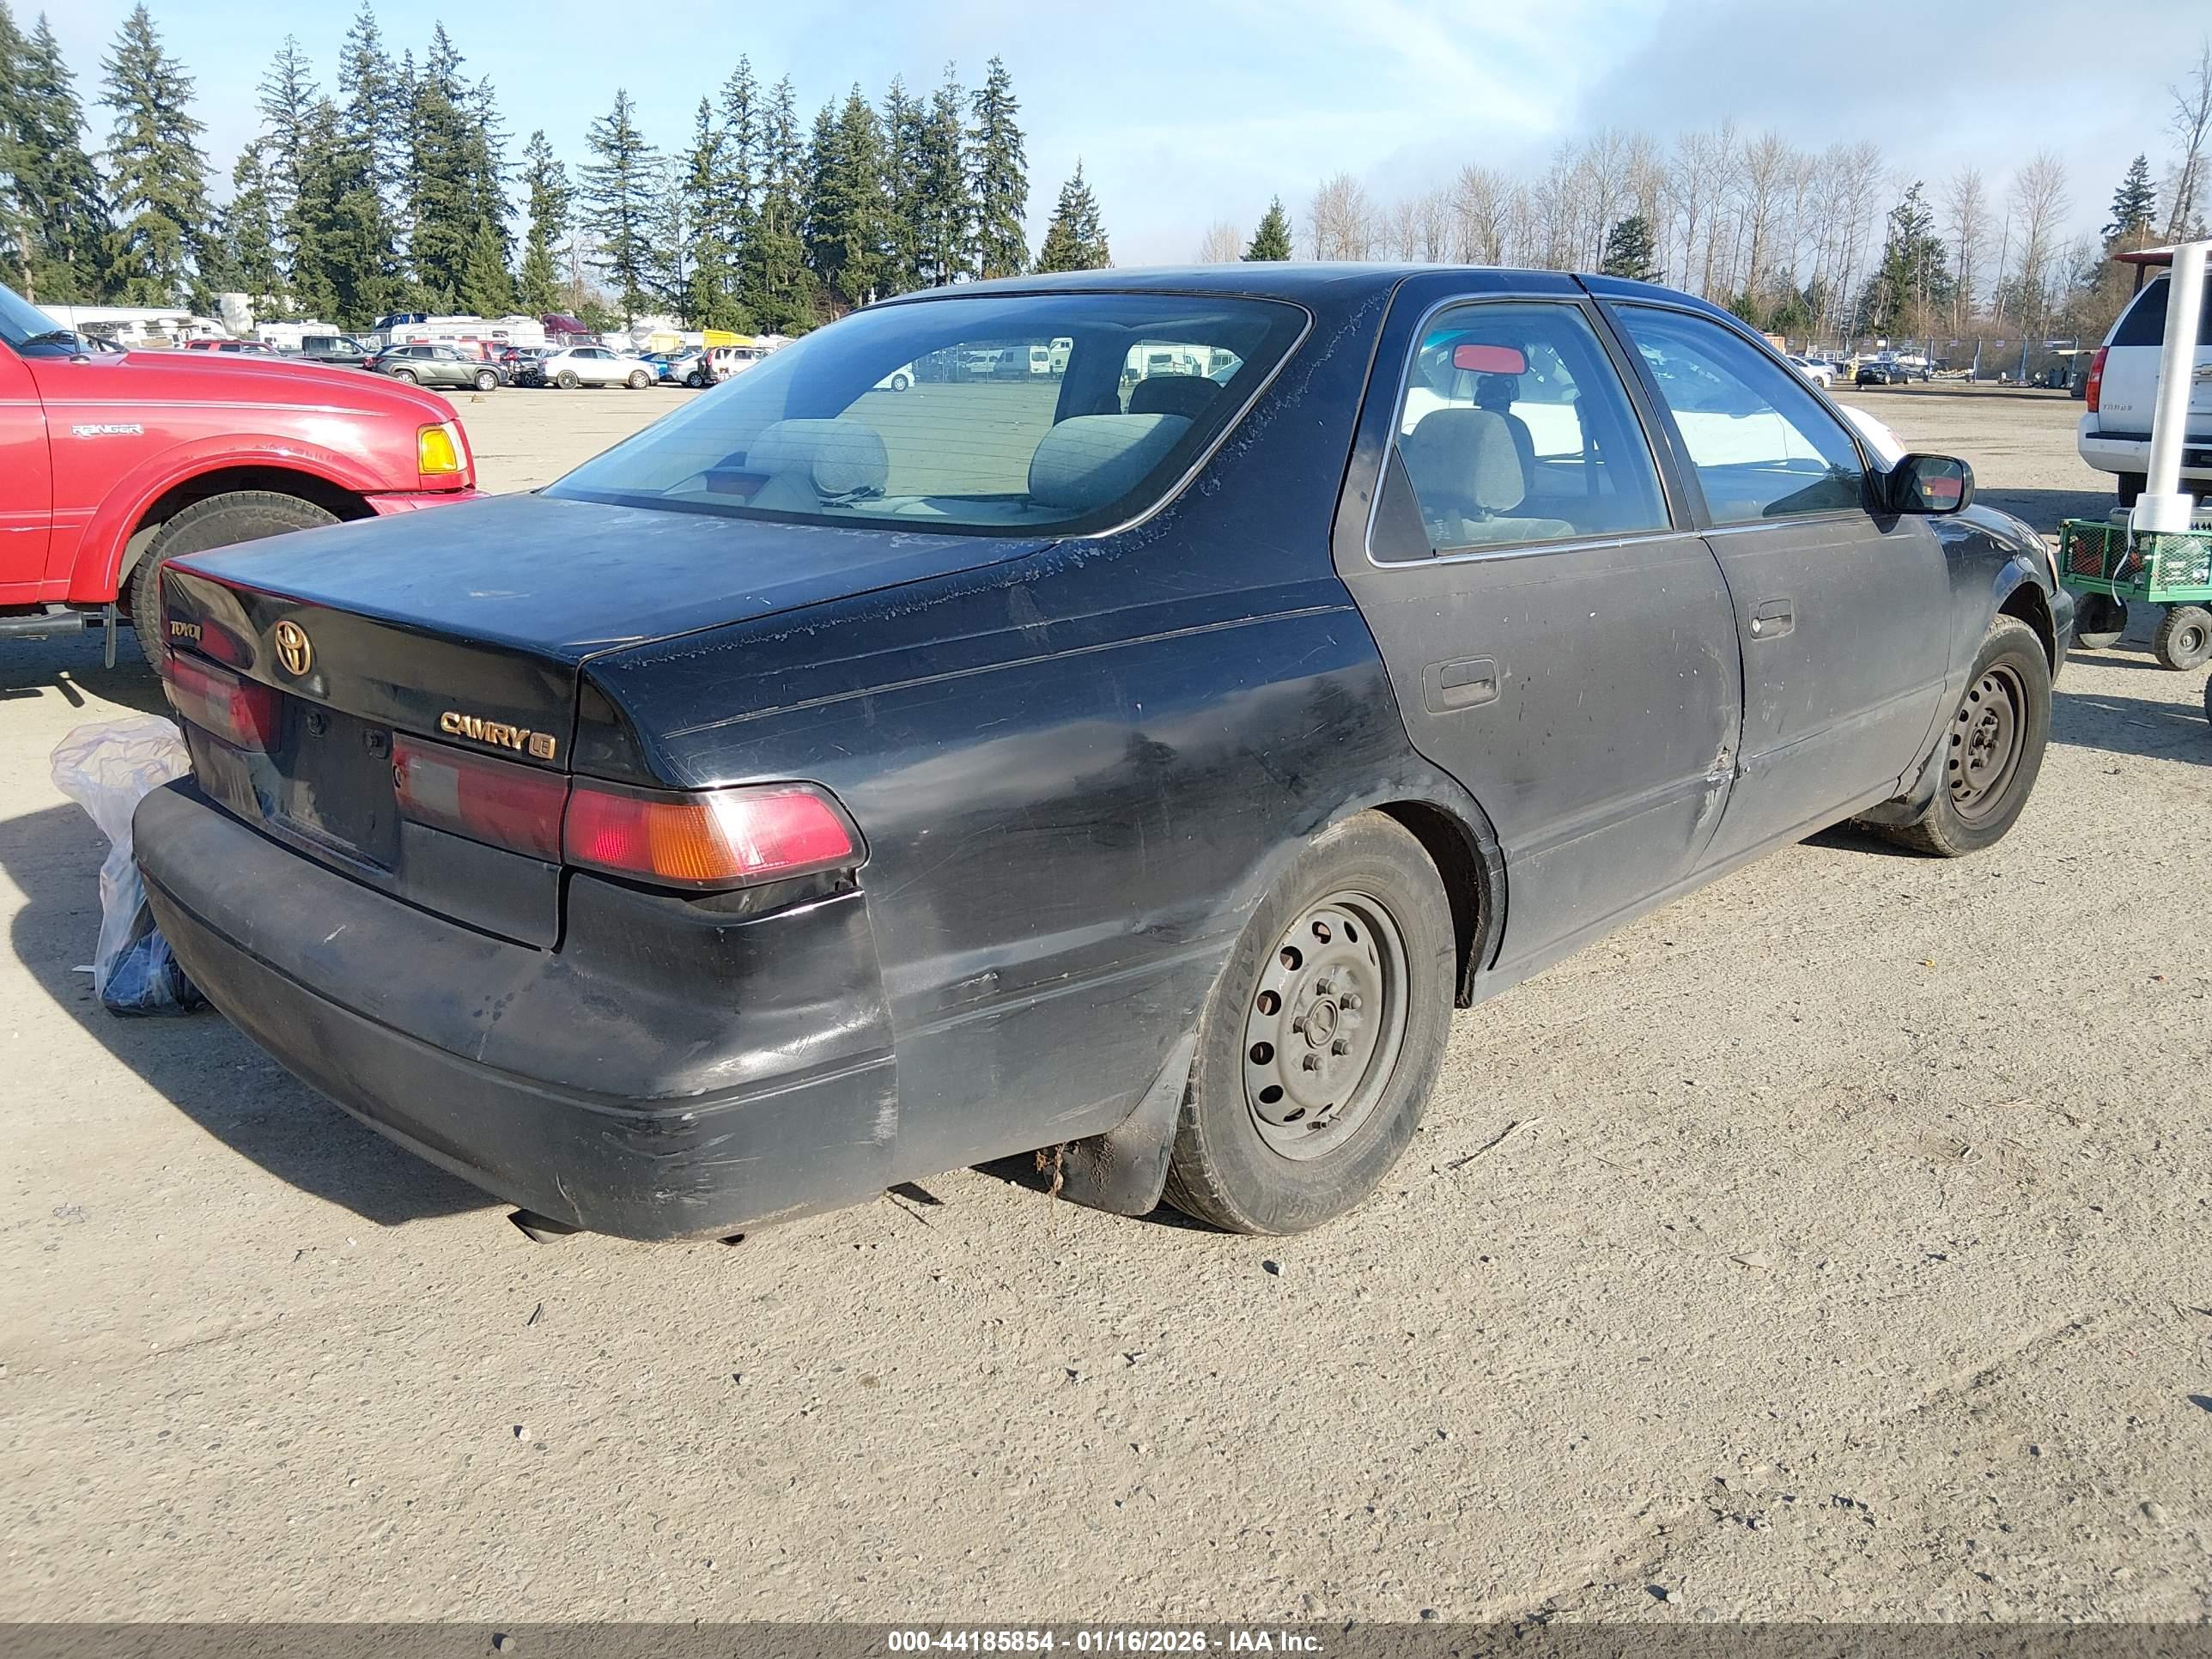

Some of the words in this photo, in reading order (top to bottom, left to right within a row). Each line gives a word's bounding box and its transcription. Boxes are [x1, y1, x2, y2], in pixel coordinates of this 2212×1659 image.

[71, 424, 143, 437] RANGER
[440, 711, 531, 750] CAMRY
[531, 733, 551, 757] LE
